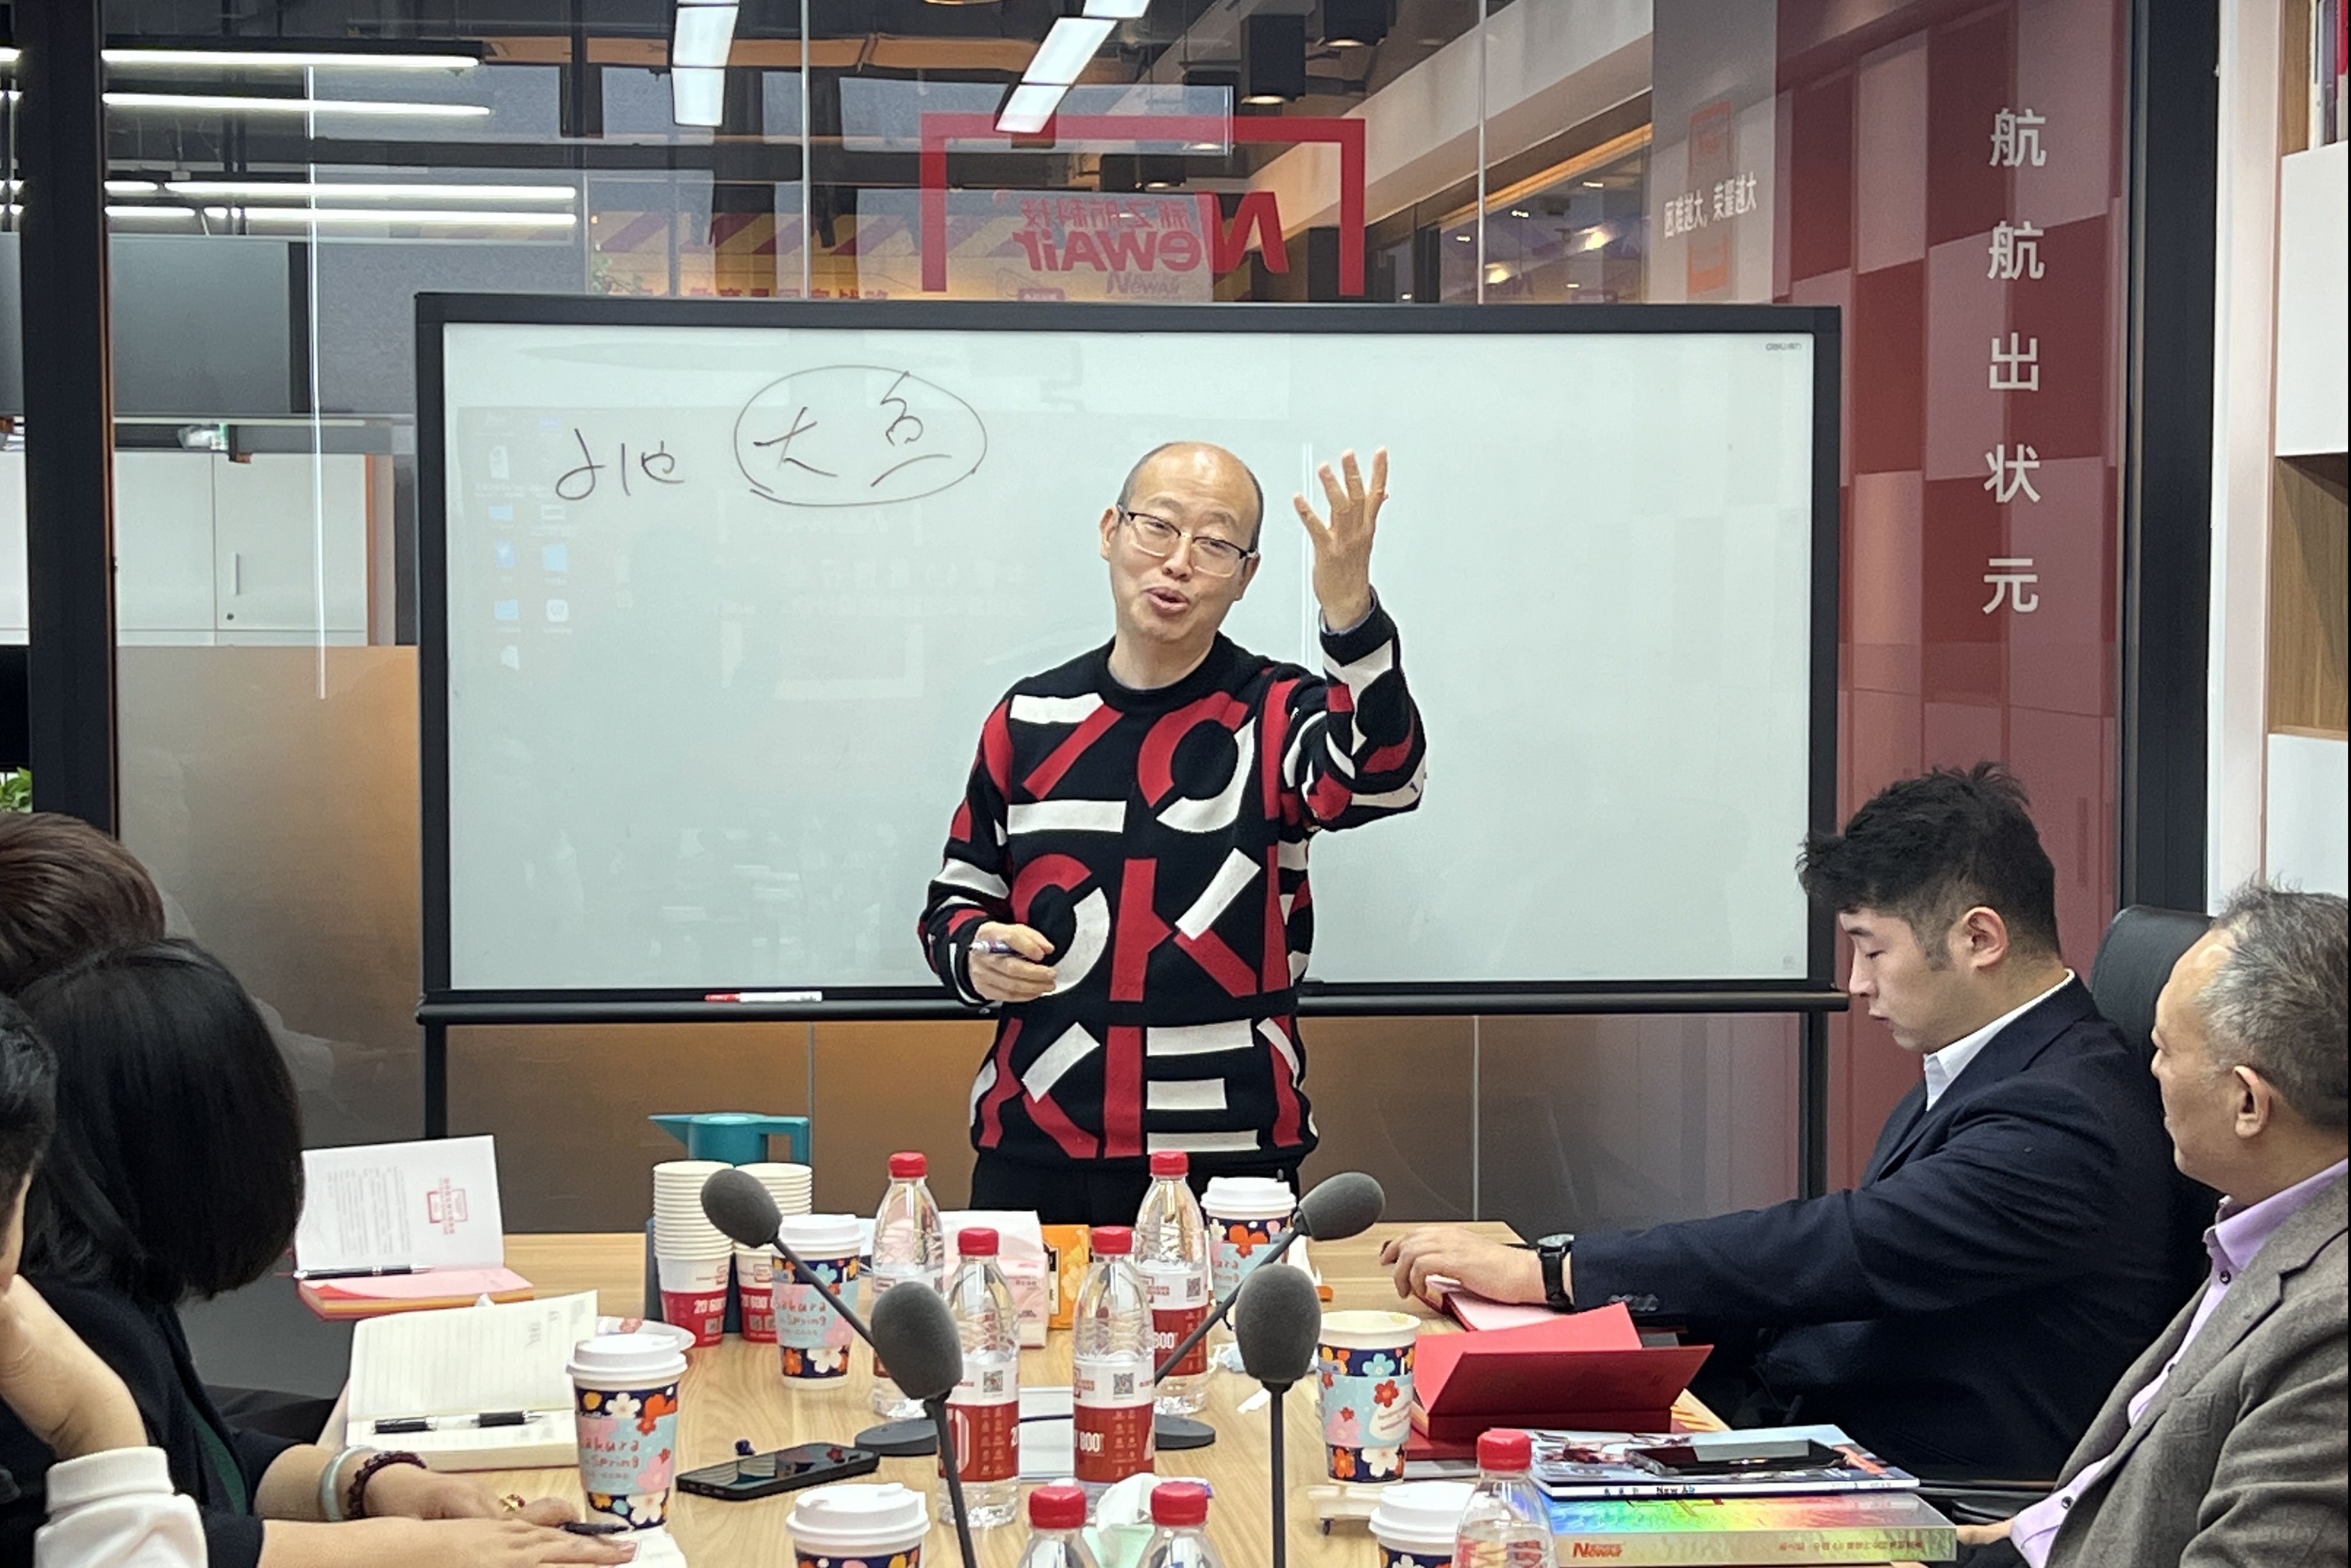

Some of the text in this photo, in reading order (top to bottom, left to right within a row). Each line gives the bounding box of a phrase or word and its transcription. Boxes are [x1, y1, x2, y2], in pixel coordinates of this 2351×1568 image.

[1982, 107, 2048, 614] 航航出状元
